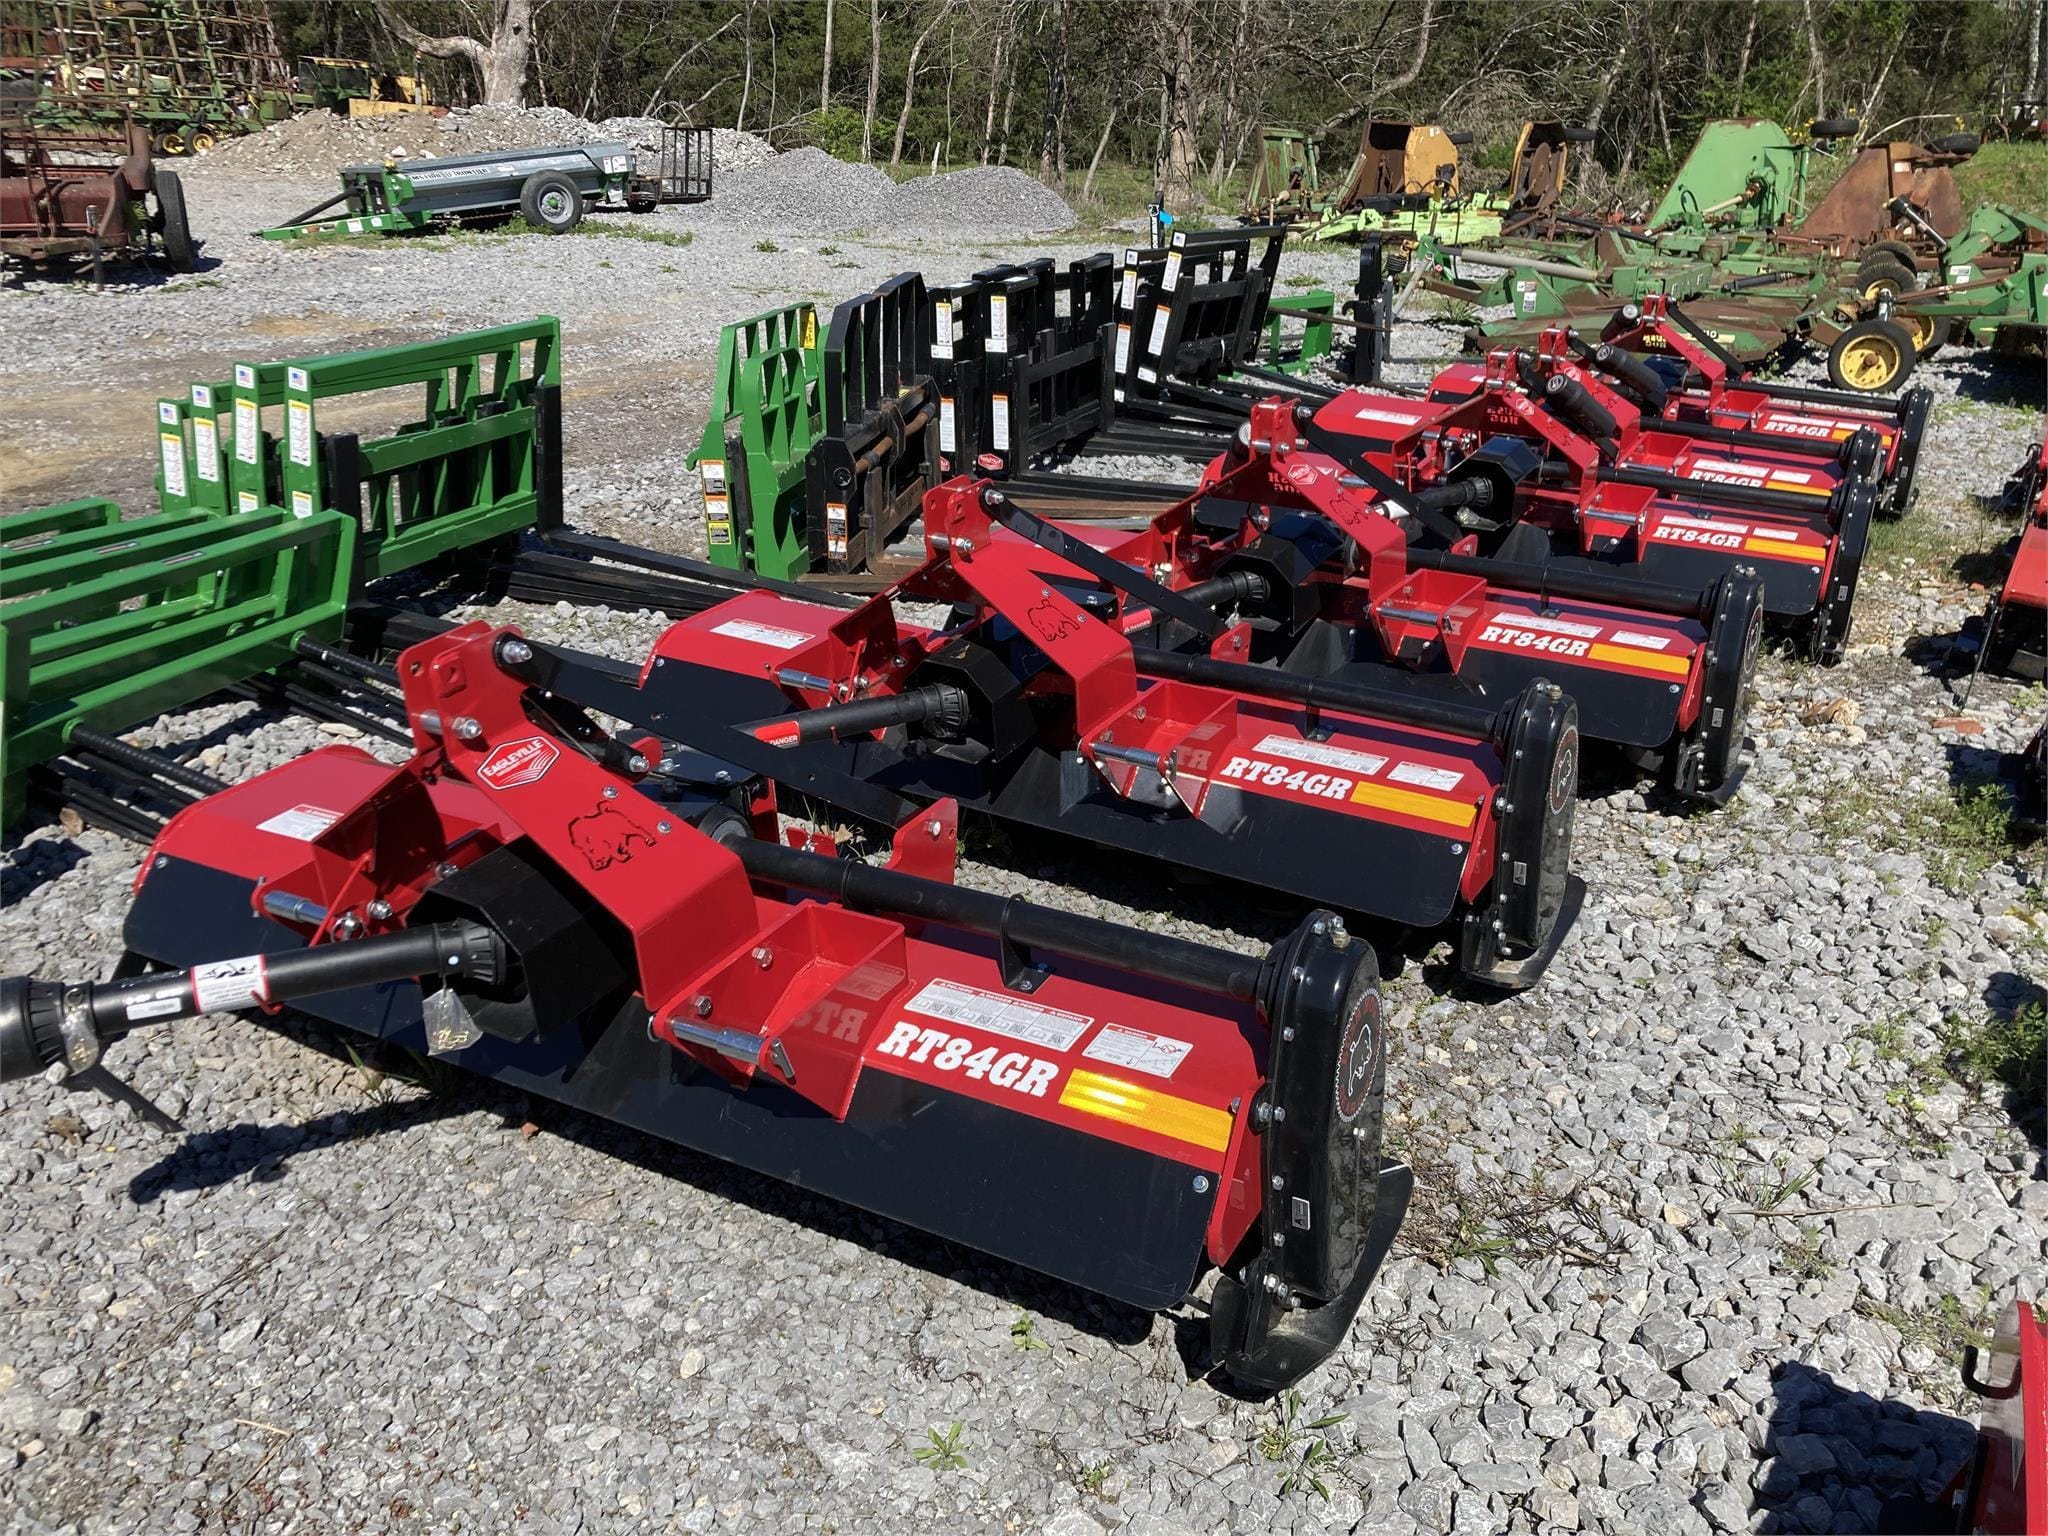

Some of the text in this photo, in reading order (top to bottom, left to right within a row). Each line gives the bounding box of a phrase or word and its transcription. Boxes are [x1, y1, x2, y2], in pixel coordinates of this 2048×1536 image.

[1763, 421, 1831, 438] RT84GR
[1652, 525, 1743, 548] RT84GR
[1479, 626, 1591, 657] RT84GR
[482, 739, 545, 777] EAGLEVILLE
[1219, 756, 1352, 801] RT84GR
[877, 1020, 1059, 1097] RT84GR
